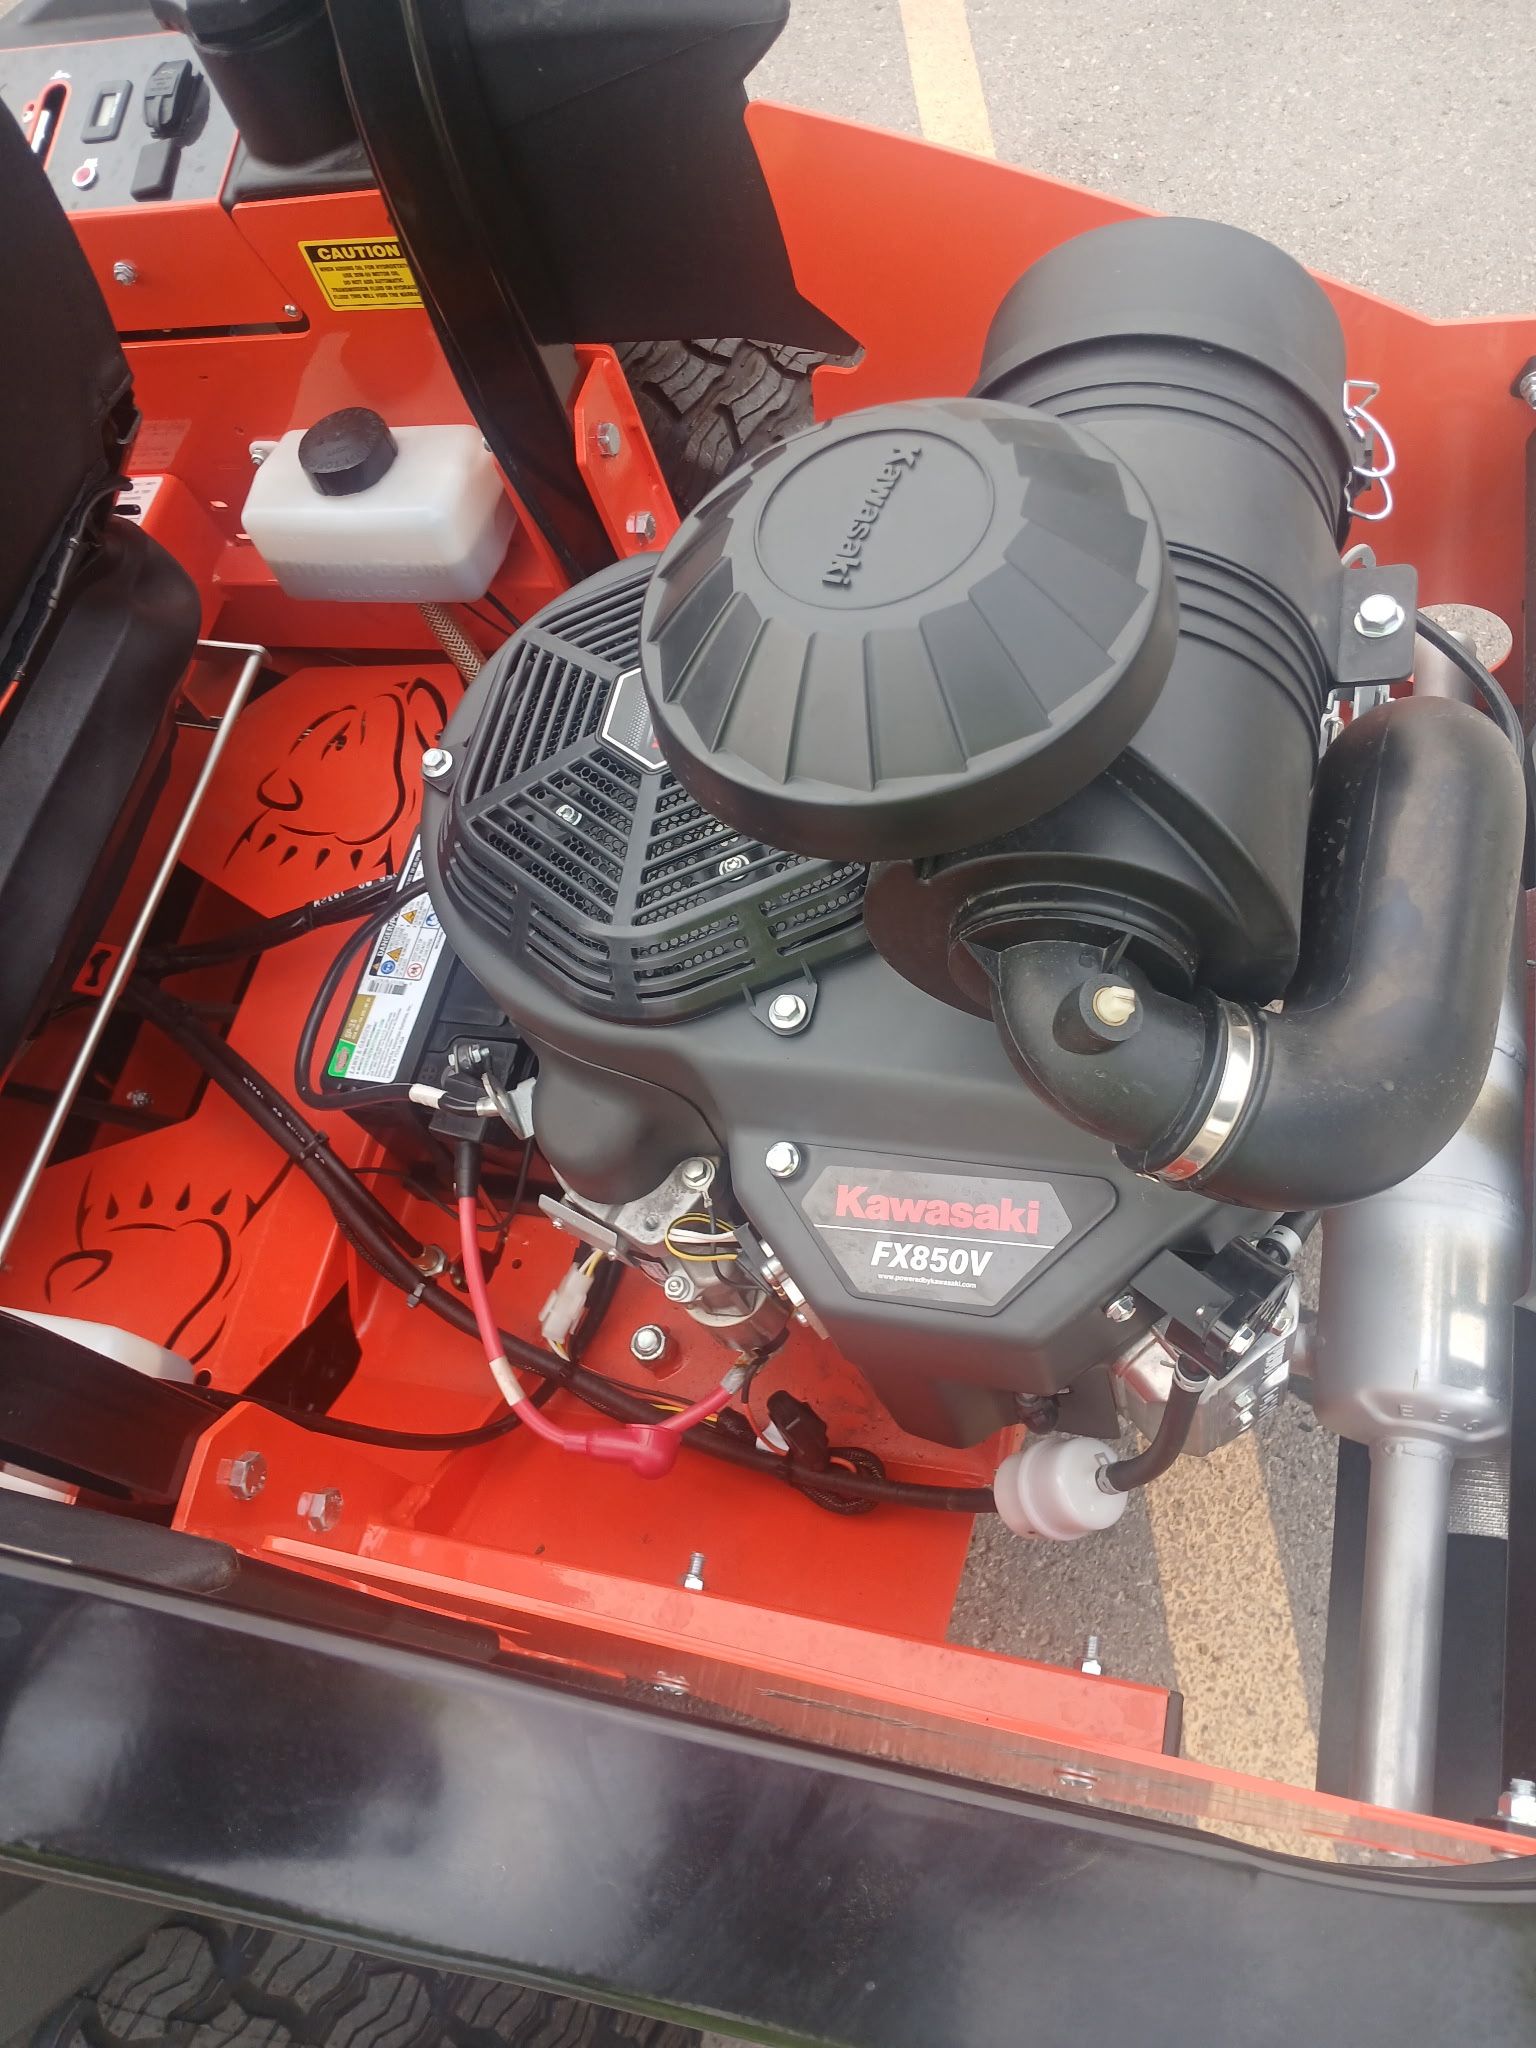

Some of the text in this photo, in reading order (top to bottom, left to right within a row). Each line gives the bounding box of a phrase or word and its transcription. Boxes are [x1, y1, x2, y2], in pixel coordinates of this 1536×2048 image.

[317, 244, 400, 260] CAUTION
[822, 449, 922, 586] Kawasaki
[835, 1184, 1040, 1234] Kawasaki
[871, 1241, 993, 1276] FX850V
